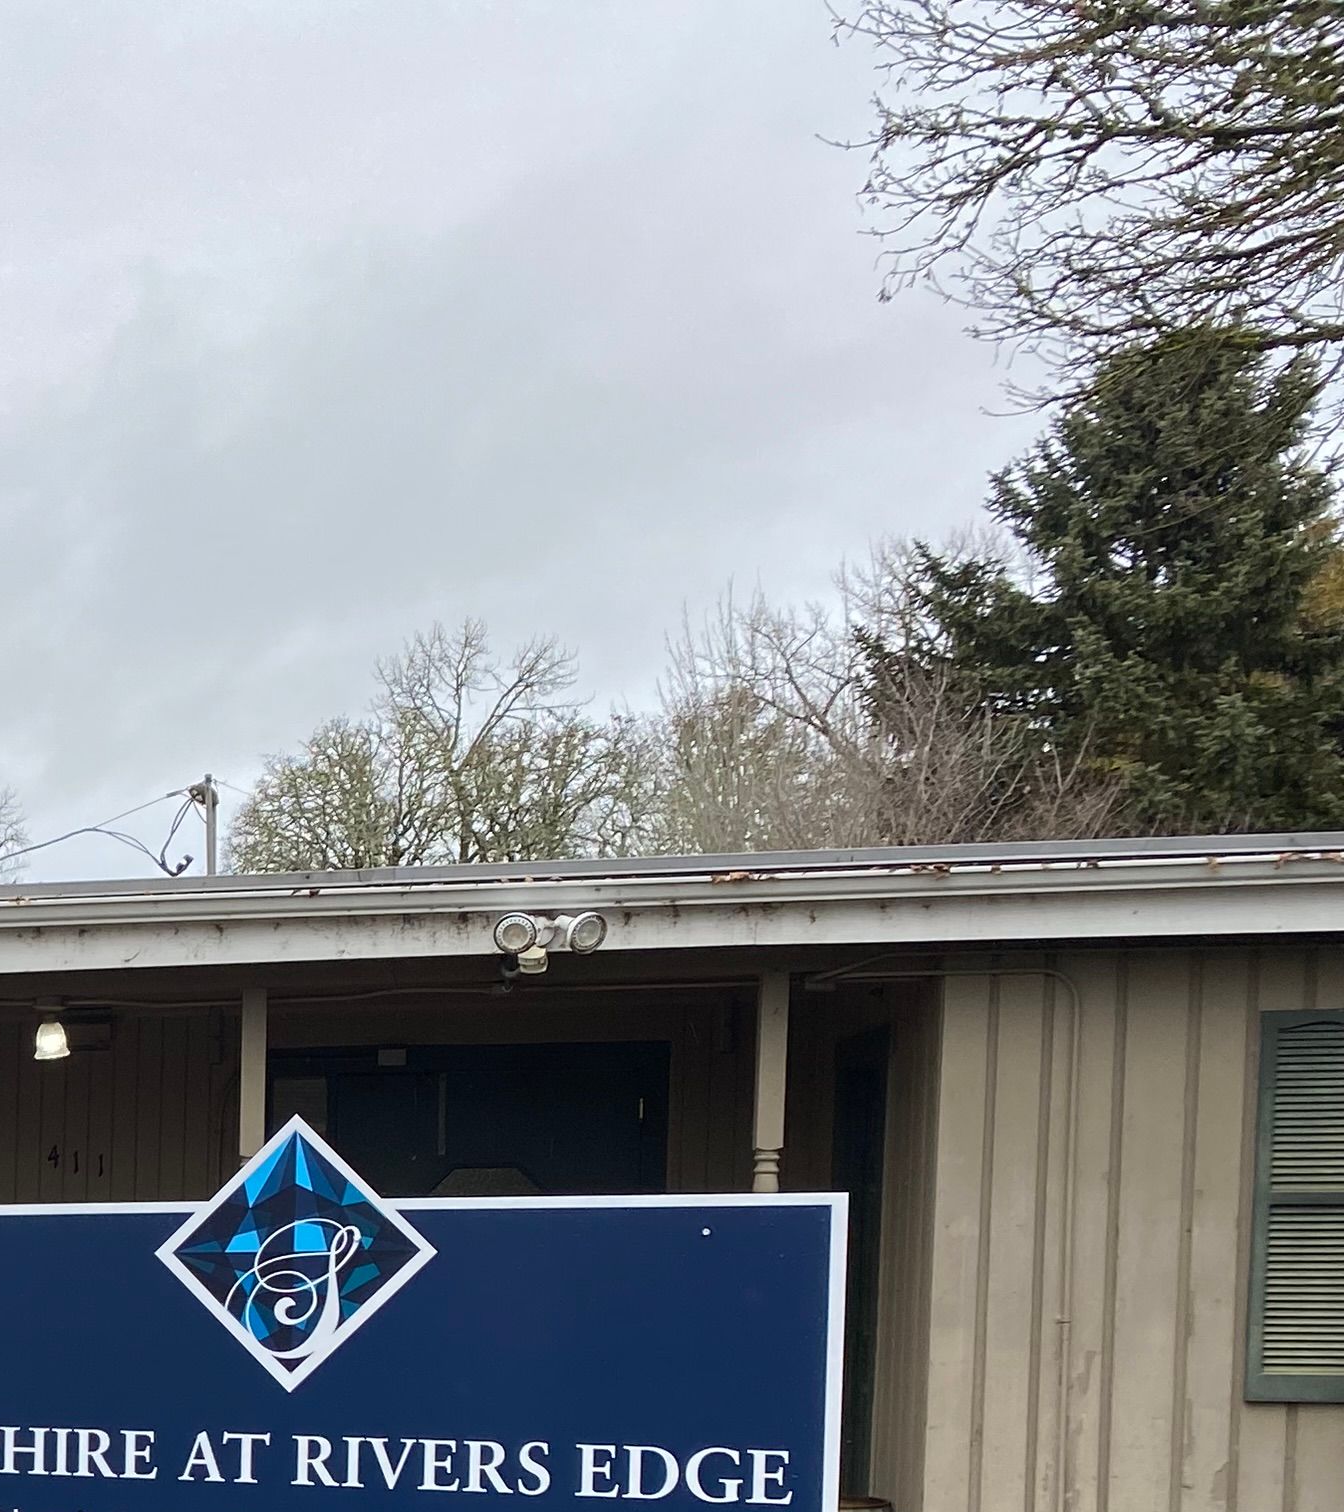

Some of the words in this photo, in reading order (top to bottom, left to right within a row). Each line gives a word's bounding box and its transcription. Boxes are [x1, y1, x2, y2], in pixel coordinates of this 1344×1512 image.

[47, 1144, 104, 1178] 411
[177, 1430, 271, 1484] AT
[290, 1434, 551, 1496] RIVERS
[574, 1443, 793, 1505] EDGE
